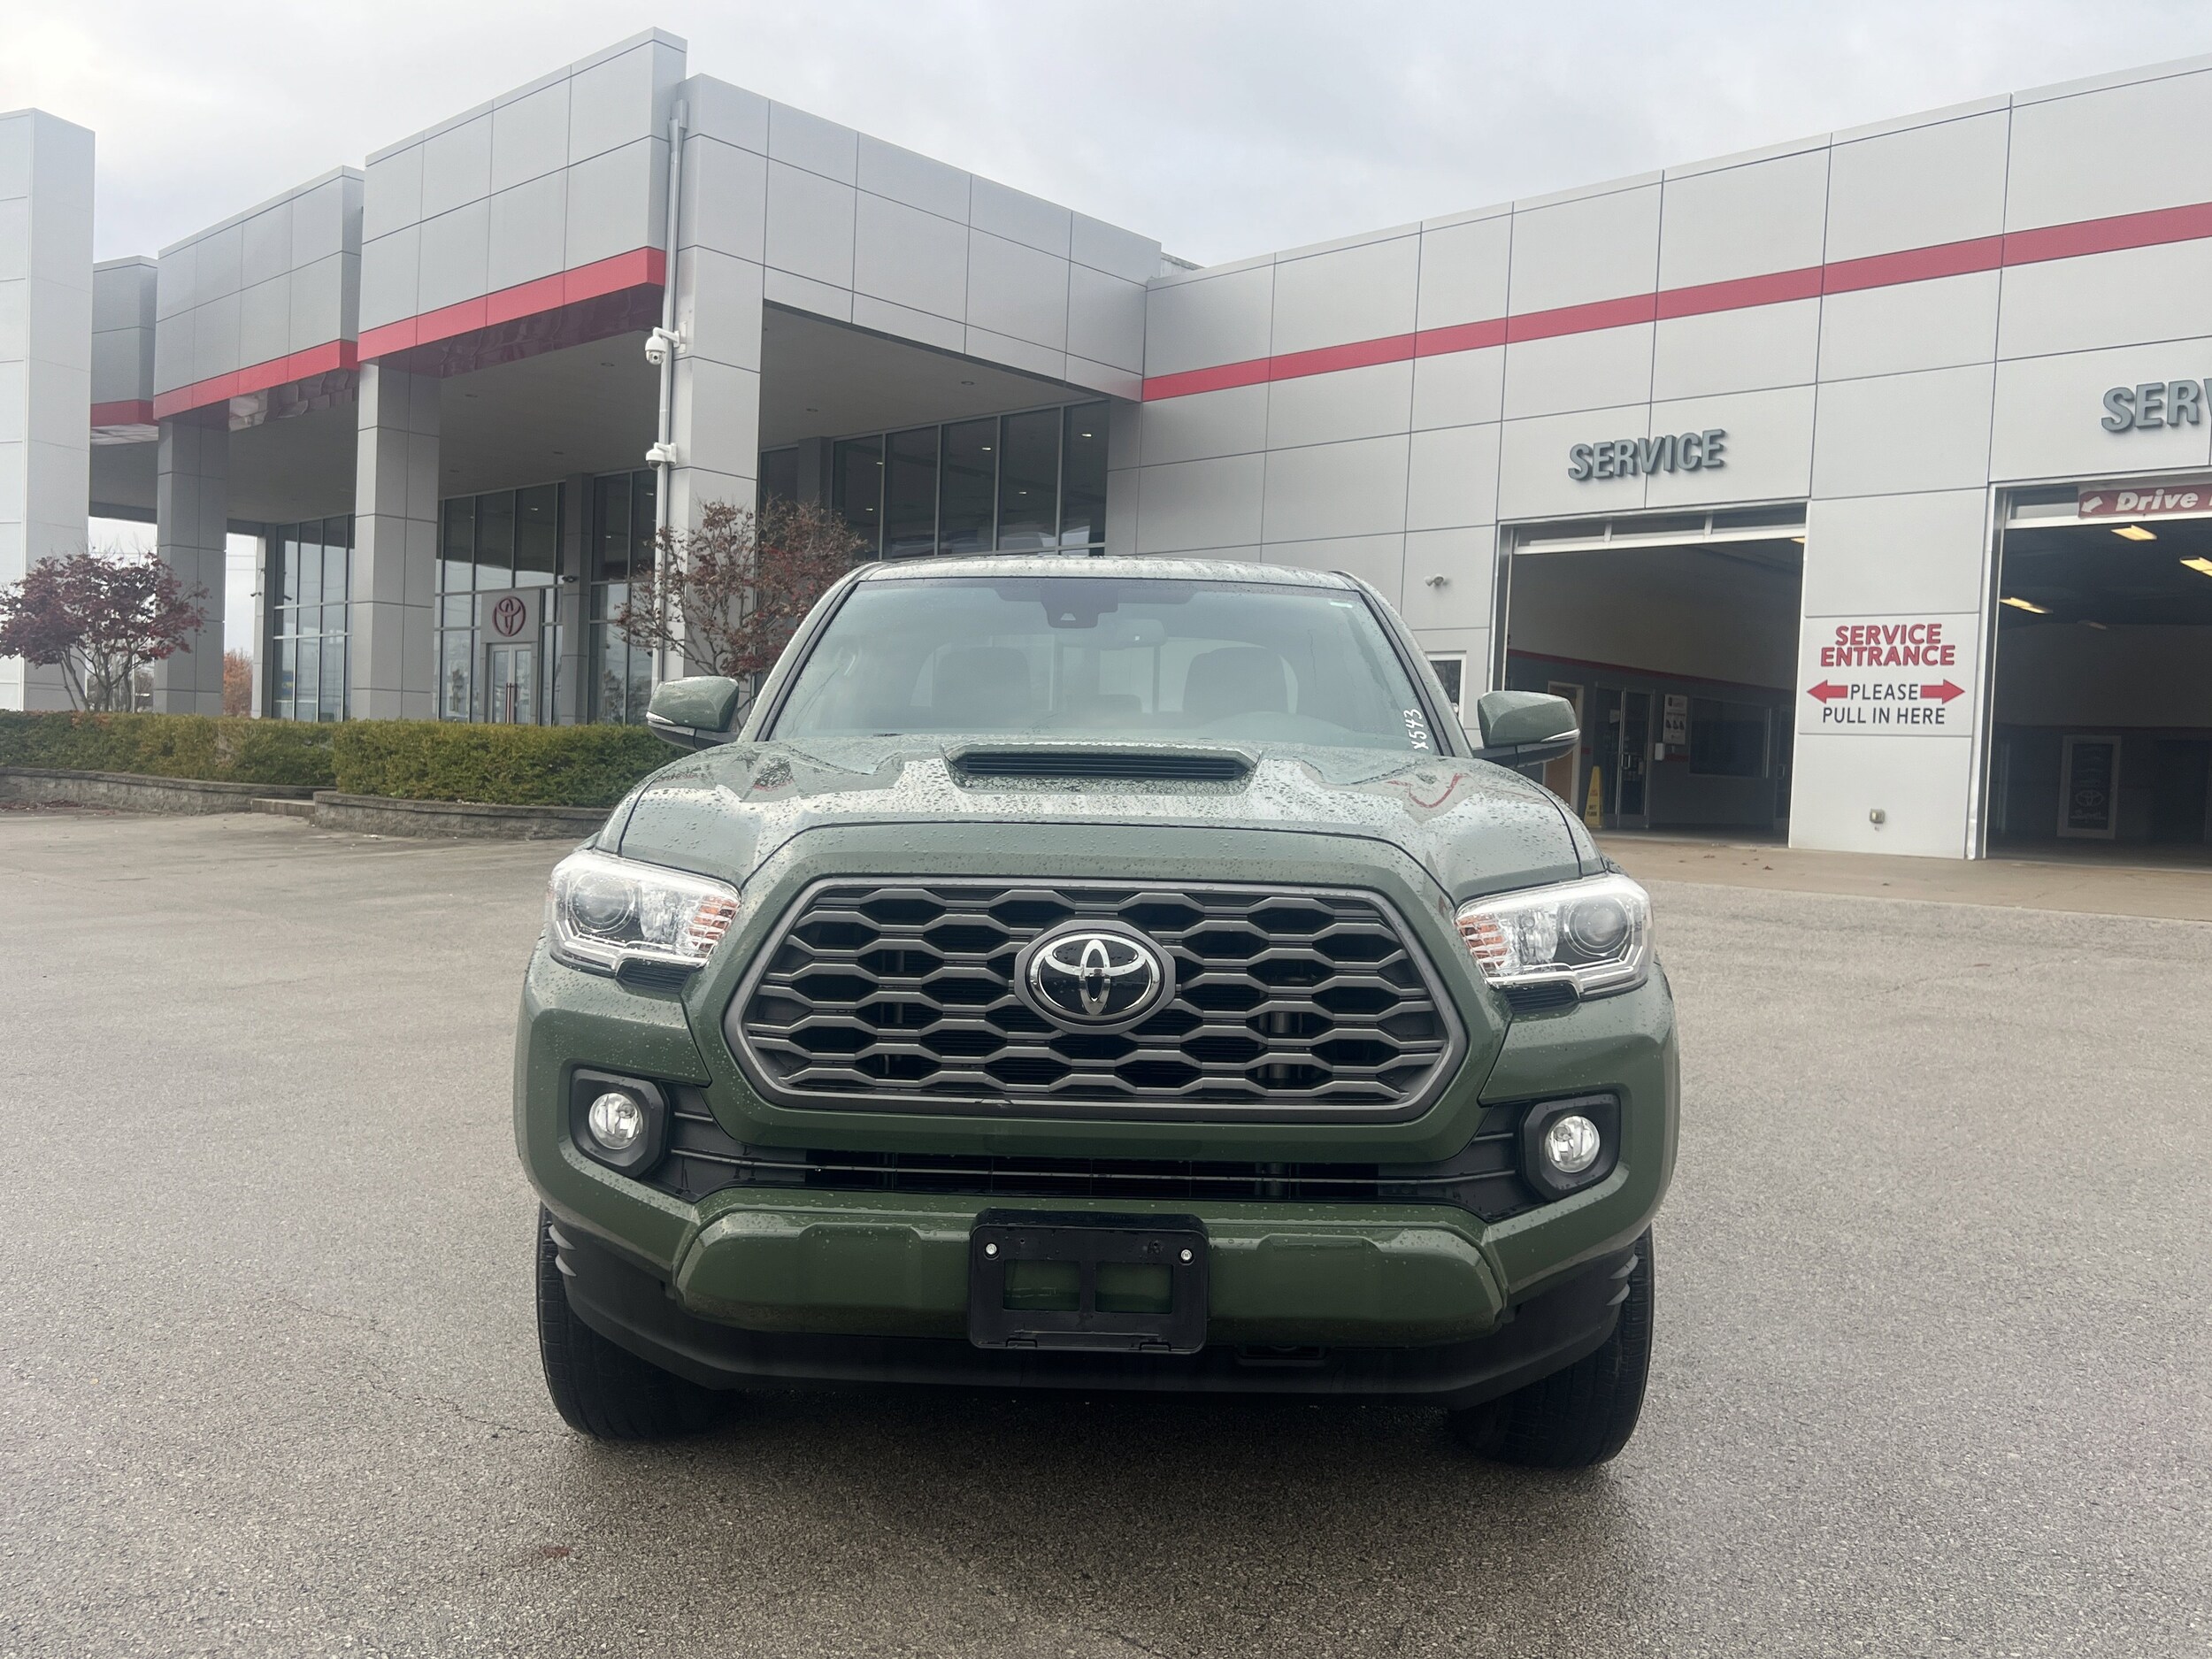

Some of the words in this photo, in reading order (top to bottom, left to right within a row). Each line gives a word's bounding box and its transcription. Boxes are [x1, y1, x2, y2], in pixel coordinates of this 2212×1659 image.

[1568, 429, 1724, 480] SERVICE
[2116, 488, 2199, 512] Drive
[1835, 623, 1942, 647] SERVICE
[1820, 644, 1956, 667] ENTRANCE
[1850, 683, 1919, 701] PLEASE
[1823, 707, 1867, 724] PULL
[1872, 707, 1890, 724] IN
[1896, 707, 1947, 725] HERE
